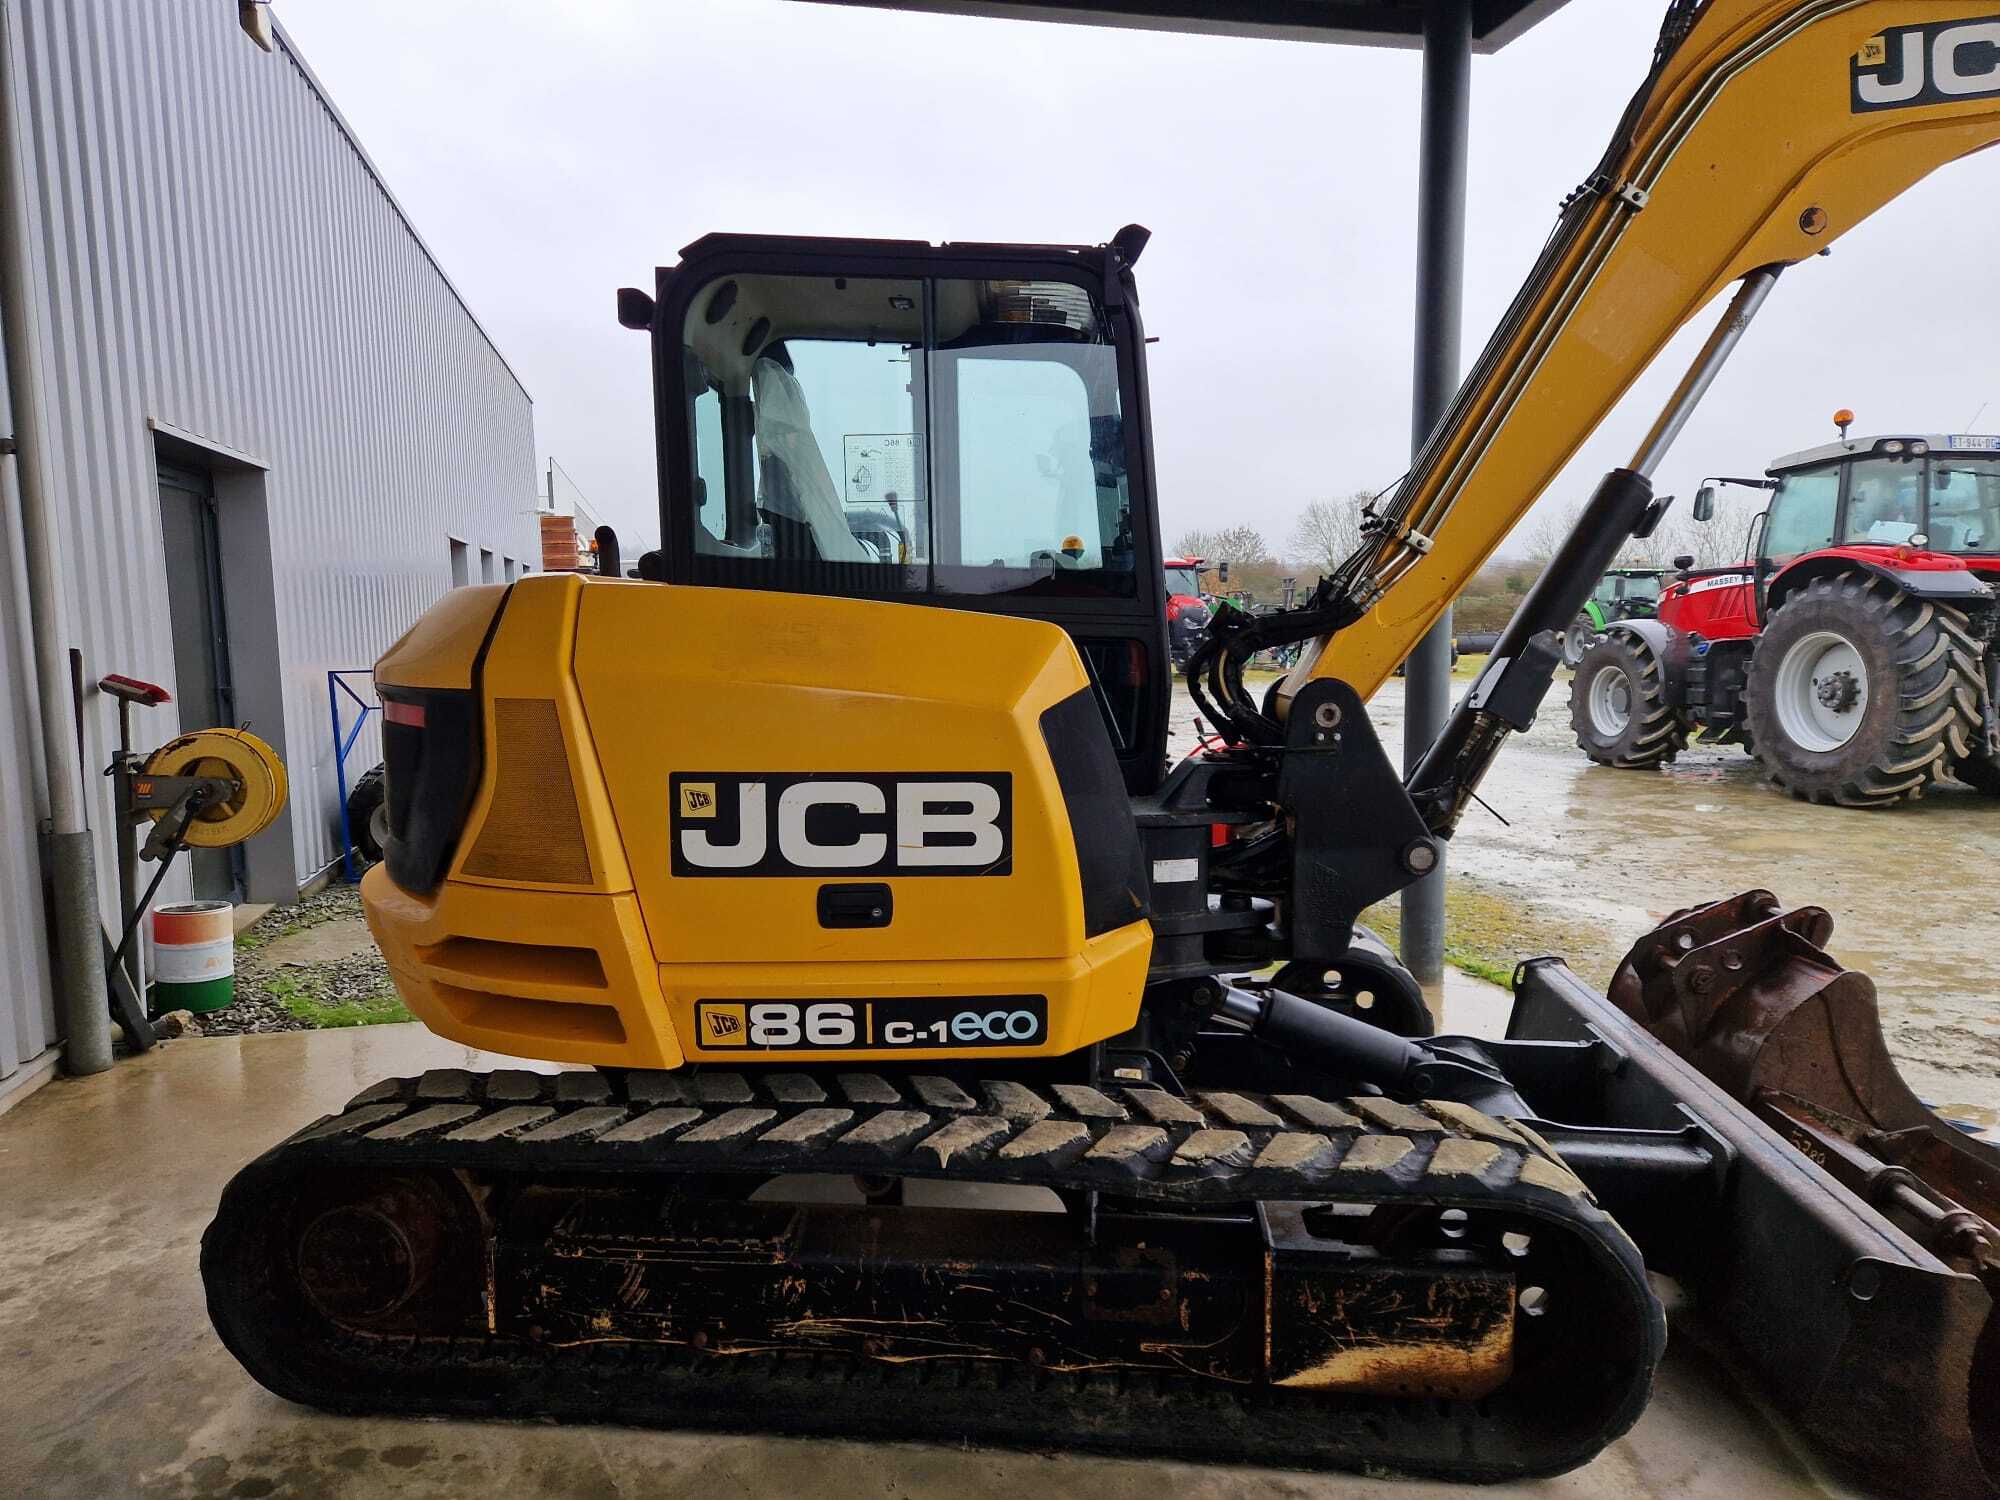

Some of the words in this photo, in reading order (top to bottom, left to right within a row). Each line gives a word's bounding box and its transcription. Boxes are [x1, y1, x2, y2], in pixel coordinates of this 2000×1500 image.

[1707, 576, 1740, 588] MASSEY
[690, 791, 710, 809] JCB
[681, 781, 1004, 868] JCB
[712, 1014, 739, 1035] JCB
[750, 1003, 856, 1045] 86
[951, 1010, 1039, 1041] eco
